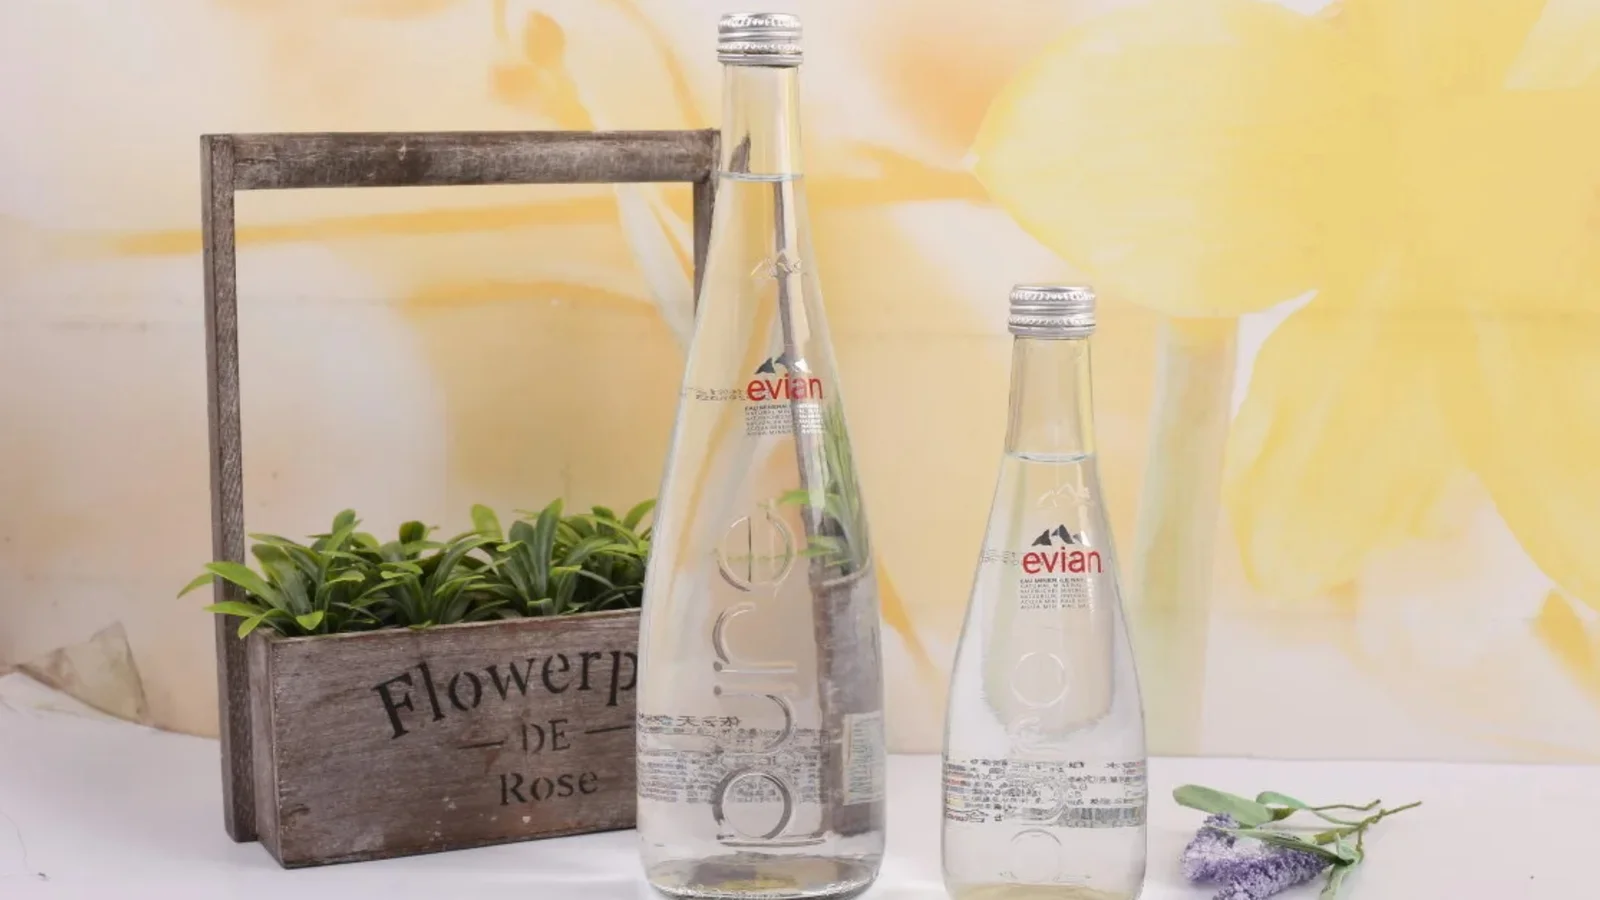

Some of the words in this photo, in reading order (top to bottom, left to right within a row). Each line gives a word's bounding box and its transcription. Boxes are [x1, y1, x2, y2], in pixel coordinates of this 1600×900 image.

[747, 373, 823, 400] evian
[1022, 546, 1102, 574] evian
[521, 719, 571, 752] DE
[500, 770, 598, 806] Rose
